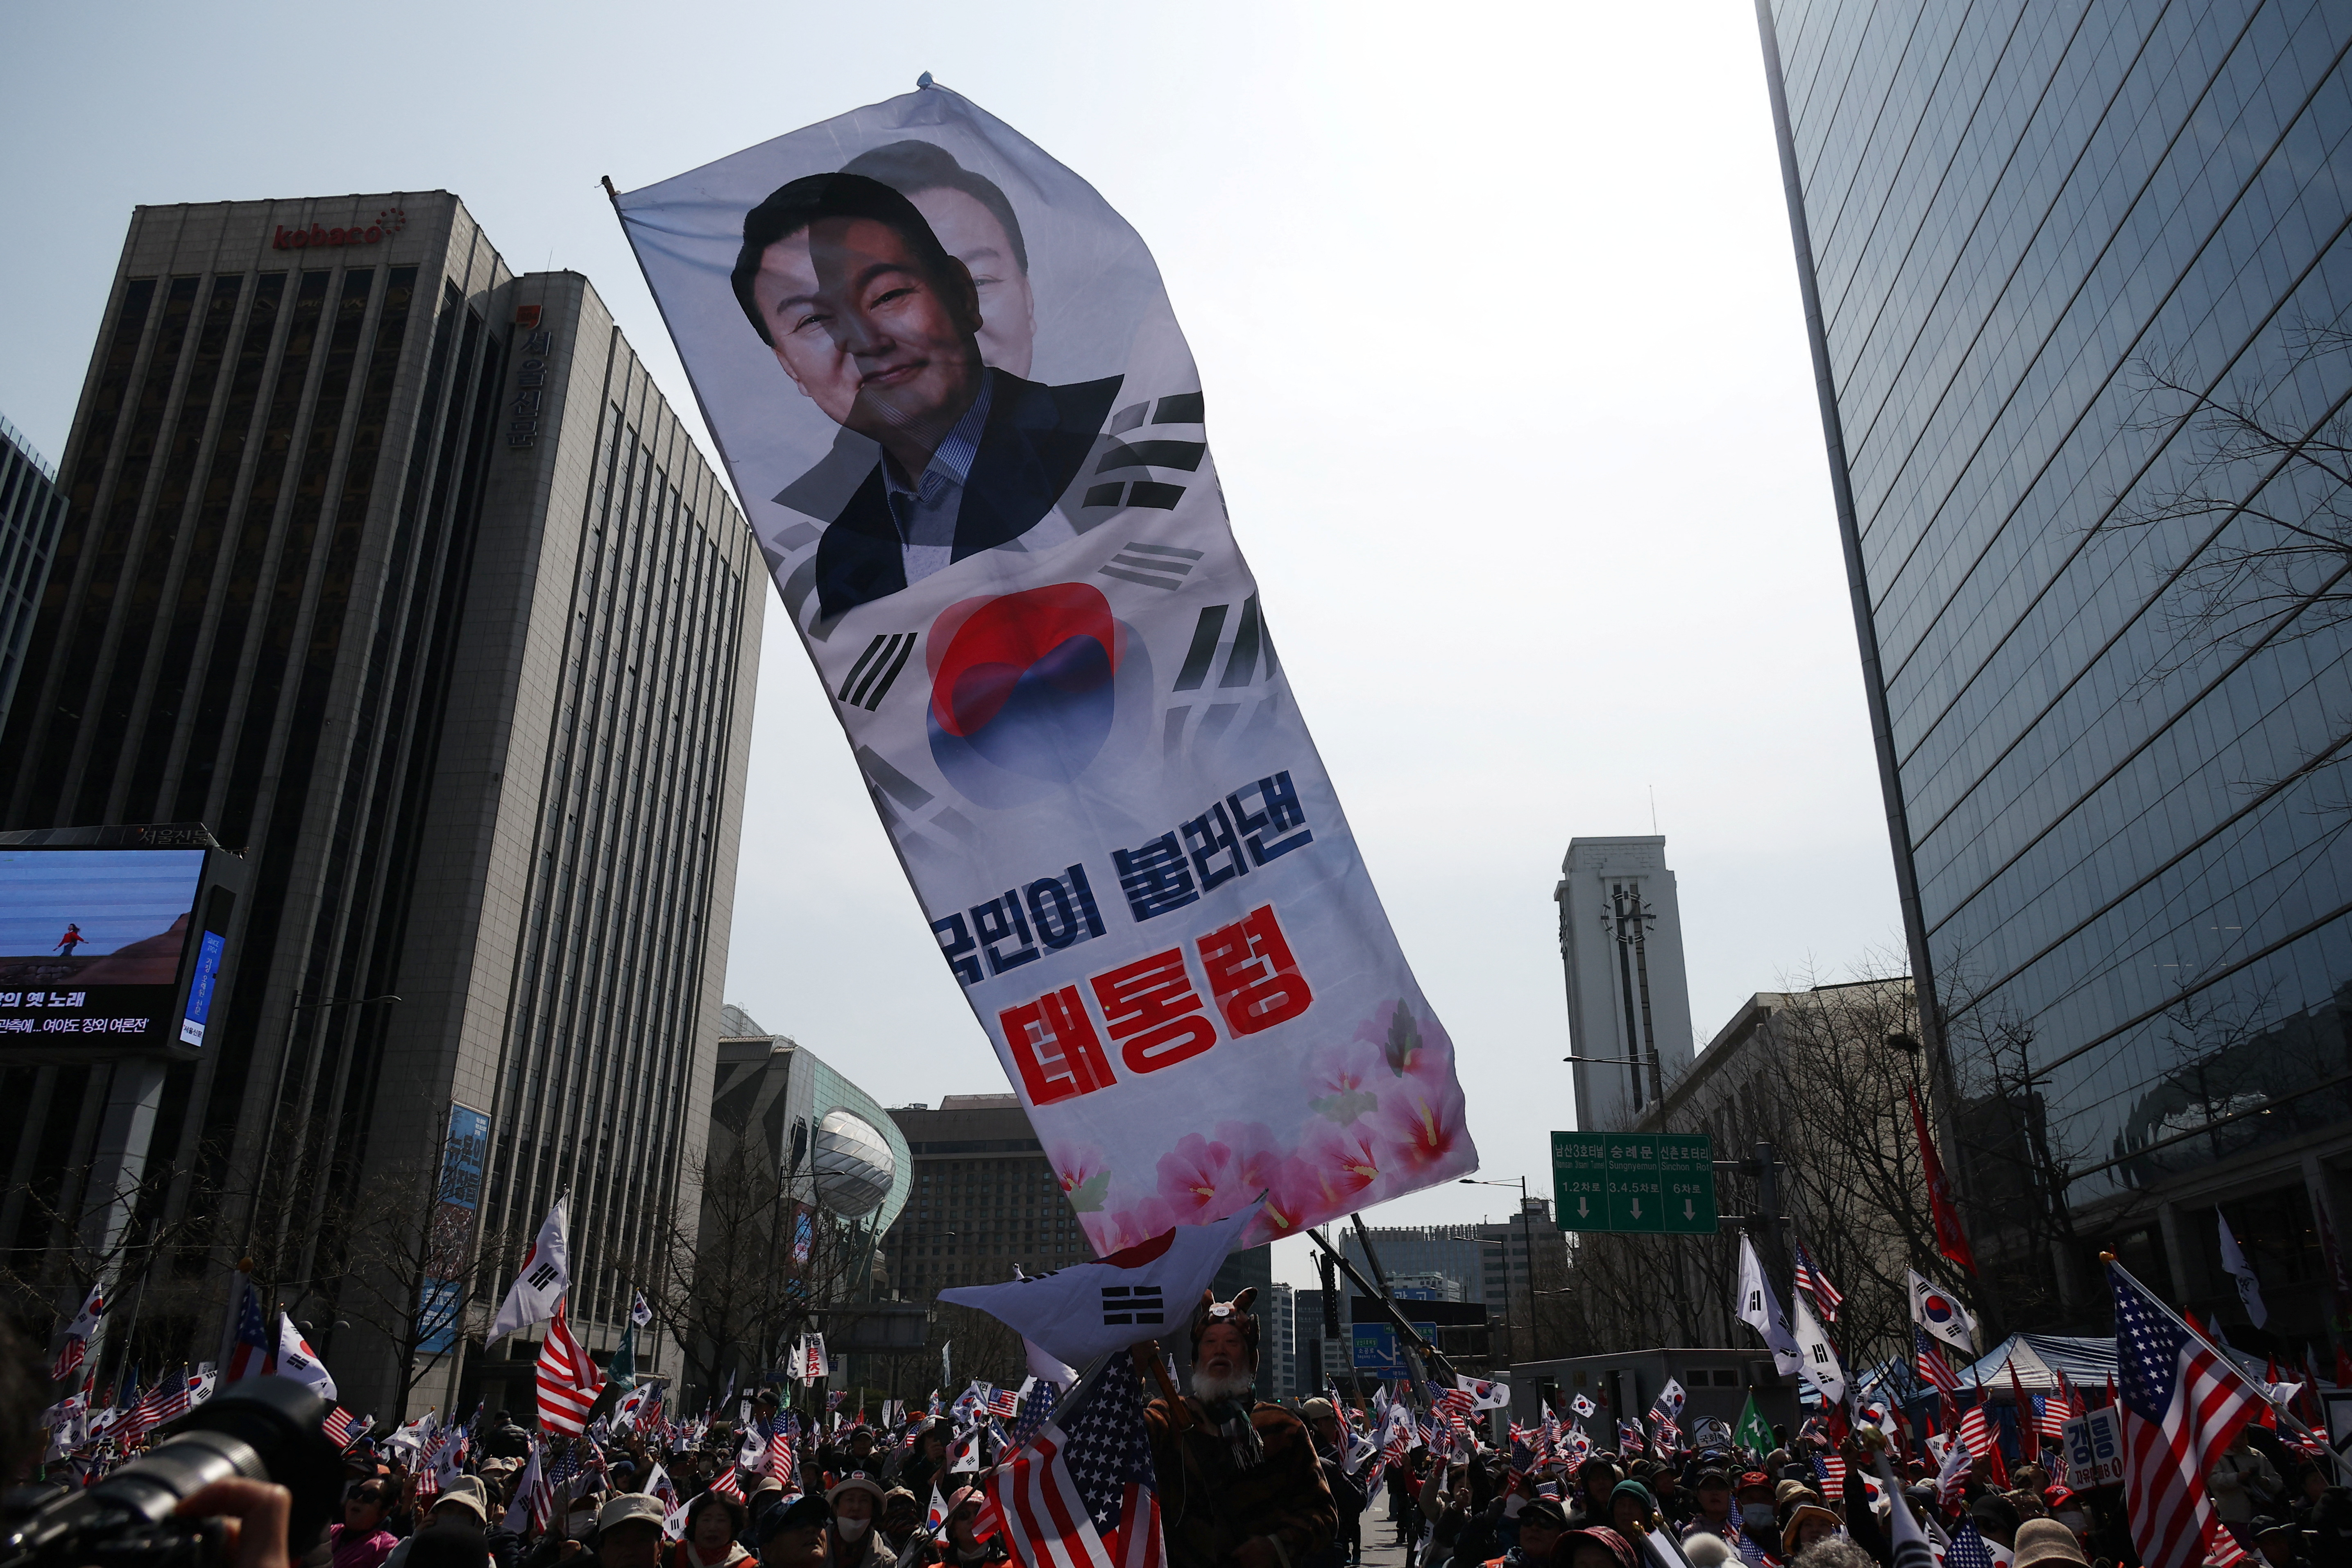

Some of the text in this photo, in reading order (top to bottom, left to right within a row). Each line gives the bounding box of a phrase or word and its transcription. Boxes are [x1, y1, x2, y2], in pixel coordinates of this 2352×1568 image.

[273, 223, 381, 249] kobaco
[506, 331, 551, 447] 서울신문
[139, 829, 207, 845] 서울신문
[1110, 770, 1314, 923] 불러낸
[207, 937, 220, 947] SINCE
[0, 992, 86, 1007] 의 옛 노래
[999, 904, 1314, 1106] 대통령
[43, 1018, 81, 1033] 여야도
[184, 1026, 202, 1038] 서울신문
[906, 1114, 972, 1123] PLAZA
[1556, 1144, 1604, 1158] 남산3호터널
[1611, 1145, 1653, 1159] 숭례문
[1660, 1146, 1708, 1160] 신촌로터리
[1609, 1160, 1657, 1171] Sungnyemun
[1661, 1161, 1690, 1171] Sinchon
[1563, 1182, 1601, 1192] 1.2차로
[1609, 1182, 1660, 1193] 3.4.5차로
[1673, 1183, 1702, 1194] 6차로
[2068, 1416, 2114, 1465] 강릉
